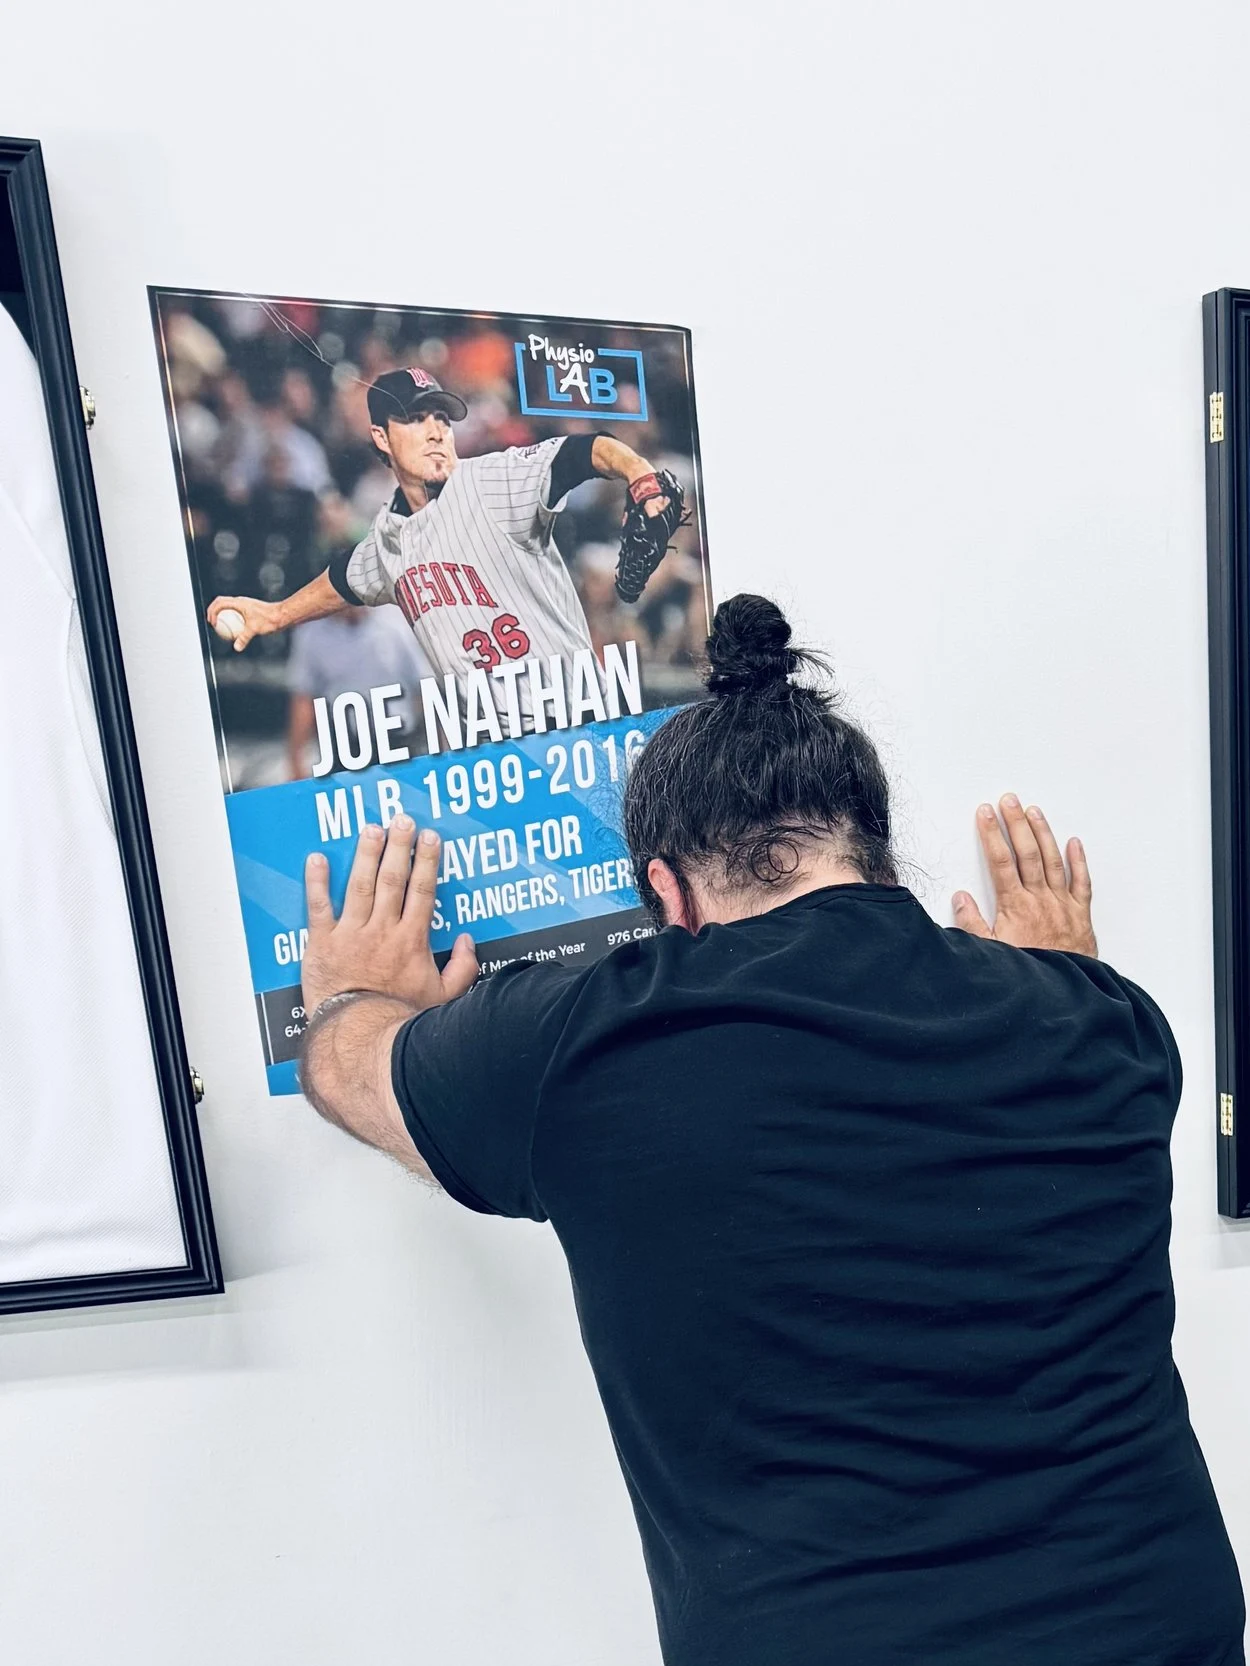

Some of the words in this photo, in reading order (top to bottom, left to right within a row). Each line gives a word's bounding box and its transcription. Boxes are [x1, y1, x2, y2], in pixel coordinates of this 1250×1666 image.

[528, 334, 595, 370] Physio
[546, 362, 618, 404] LAB
[463, 613, 530, 673] 36
[312, 683, 410, 778] JOE
[420, 640, 643, 755] NATHAN
[525, 815, 583, 865] FOR
[456, 874, 566, 925] RANGERS,
[568, 858, 637, 900] TIGER
[558, 942, 586, 957] Year
[607, 931, 630, 946] 976
